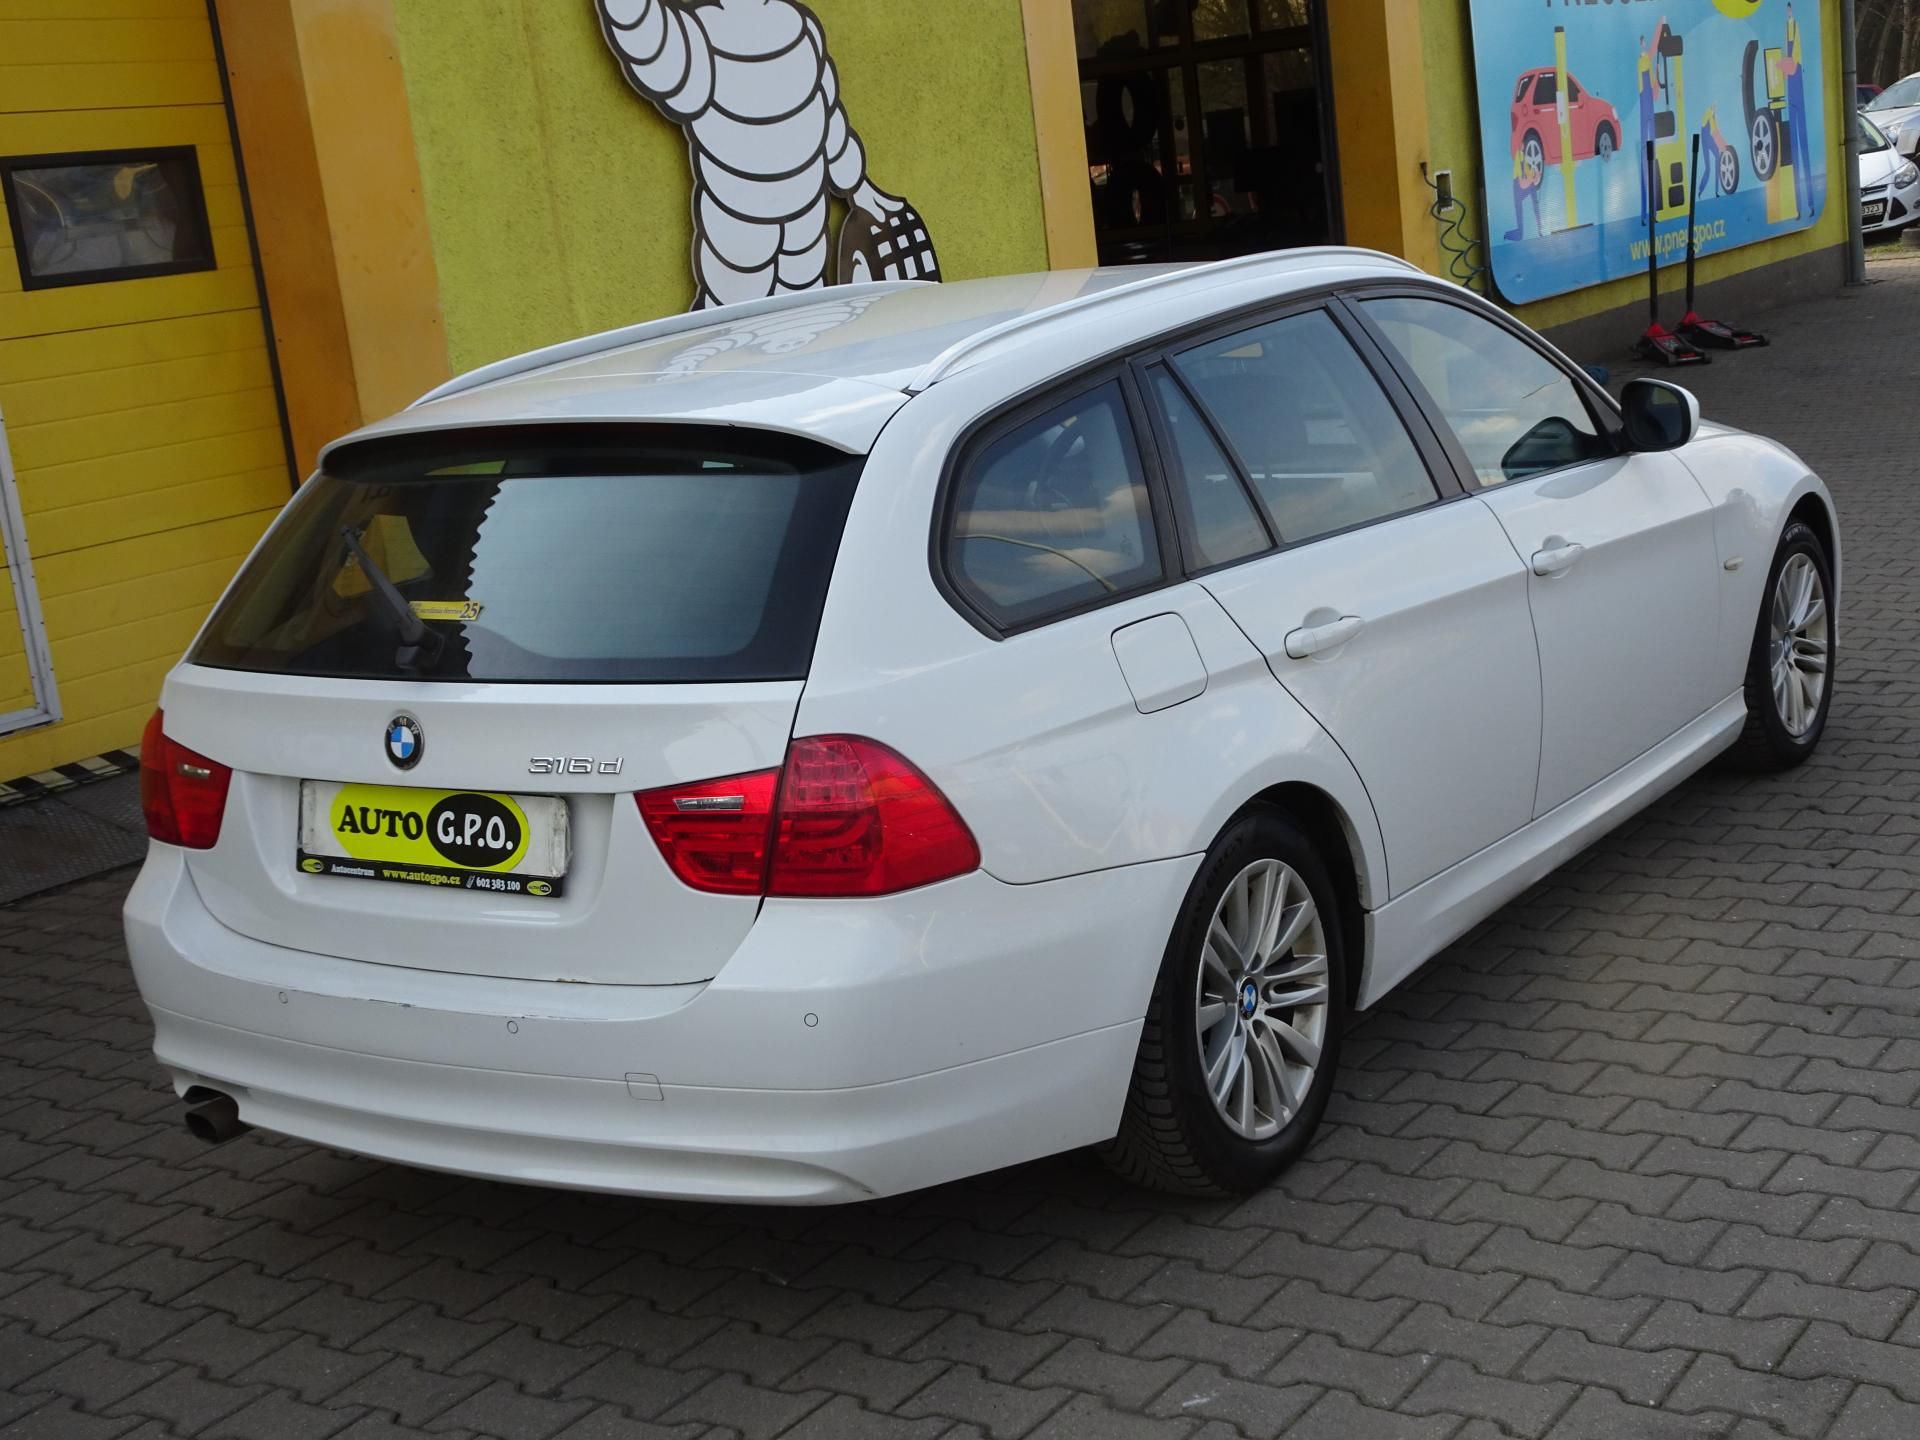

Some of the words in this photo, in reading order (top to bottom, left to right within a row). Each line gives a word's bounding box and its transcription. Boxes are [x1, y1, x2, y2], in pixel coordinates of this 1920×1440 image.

[459, 602, 479, 619] 25
[528, 757, 624, 774] 316d
[337, 804, 424, 841] AUTO
[437, 810, 513, 850] G.P.O.
[331, 864, 375, 877] Autocentrum
[382, 868, 461, 885] www.autogpo.cz
[476, 876, 490, 888] 602
[491, 879, 505, 891] 383
[506, 881, 521, 891] 100
